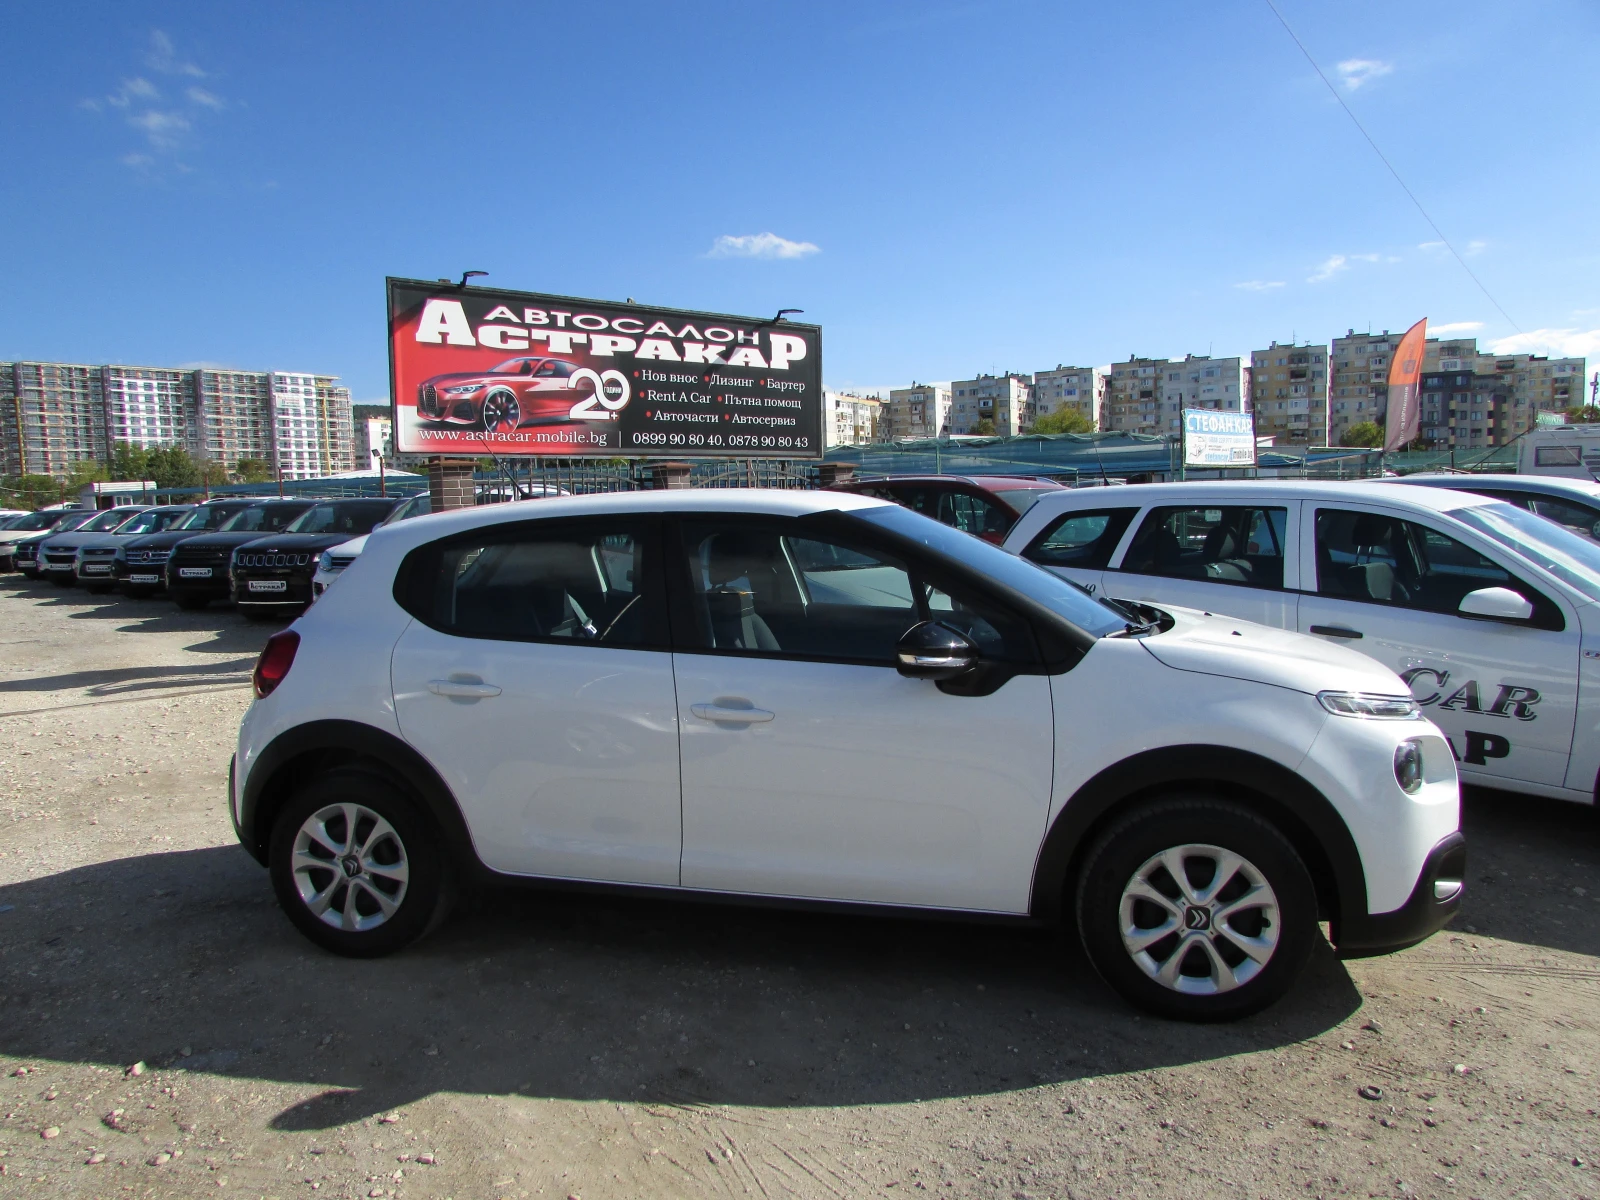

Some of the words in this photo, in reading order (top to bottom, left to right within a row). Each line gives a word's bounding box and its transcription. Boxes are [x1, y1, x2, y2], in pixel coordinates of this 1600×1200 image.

[484, 306, 760, 345] АВТОСАЛОН
[641, 369, 667, 382] Нов
[670, 372, 698, 384] внос
[711, 374, 754, 388] Лизинг
[766, 379, 806, 392] Бартер
[647, 390, 676, 403] Rent
[679, 391, 690, 403] A
[690, 392, 711, 404] Car
[724, 394, 762, 406] Пътна
[764, 398, 801, 410] помощ
[653, 410, 719, 423] Авточасти
[731, 413, 796, 427] Автосервиз
[418, 429, 607, 447] www.astracar.mobile.bg
[633, 432, 667, 445] 0899
[669, 433, 686, 445] 90
[689, 434, 704, 446] 80
[728, 434, 759, 447] 0878
[761, 435, 775, 447] 90
[778, 436, 792, 447] 80
[794, 436, 809, 448] 43
[1400, 667, 1541, 721] CAR
